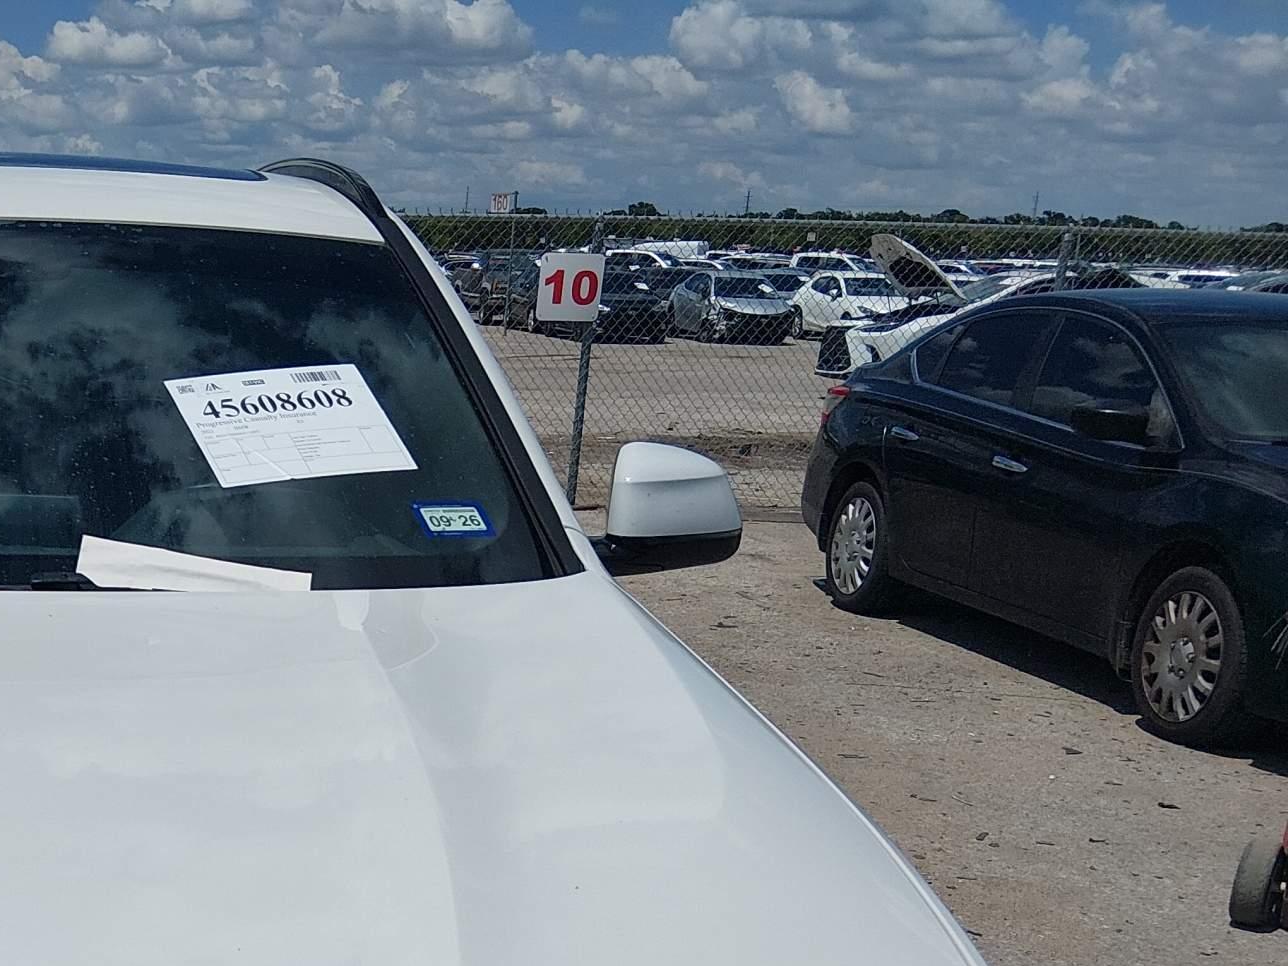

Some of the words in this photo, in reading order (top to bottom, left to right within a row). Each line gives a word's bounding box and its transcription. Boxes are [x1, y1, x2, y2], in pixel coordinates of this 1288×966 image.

[545, 269, 599, 305] 10
[202, 387, 353, 418] 45608608
[429, 515, 452, 527] 09
[458, 515, 481, 527] 26
